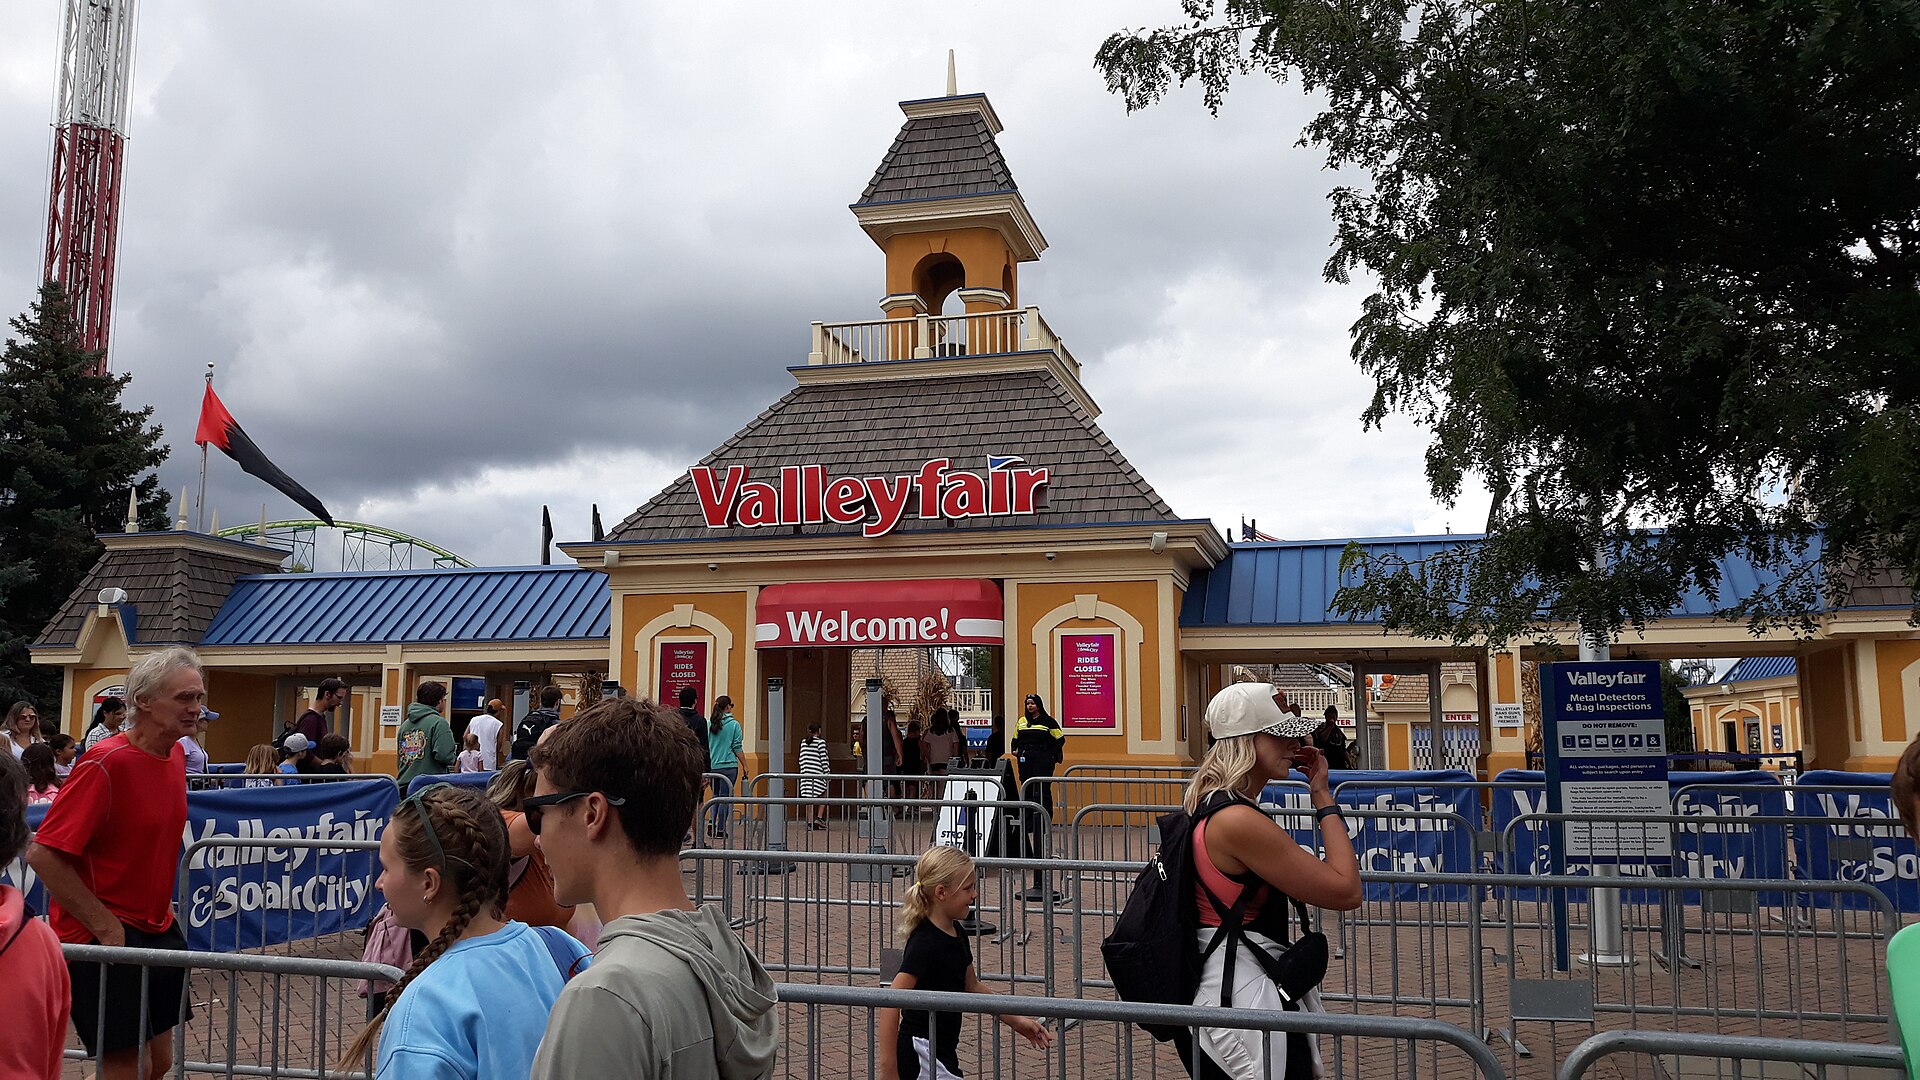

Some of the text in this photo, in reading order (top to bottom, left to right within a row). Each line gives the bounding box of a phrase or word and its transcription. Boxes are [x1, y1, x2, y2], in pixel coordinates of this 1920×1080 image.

[689, 454, 1051, 538] Valleyfair
[785, 608, 949, 643] Welcome!
[1566, 672, 1647, 687] Valleyfair
[1570, 693, 1646, 702] Metal Detectors
[1576, 703, 1594, 712] Bag
[1596, 702, 1652, 712] Inspections
[182, 810, 383, 871] Valleyfair
[940, 831, 983, 840] STROR
